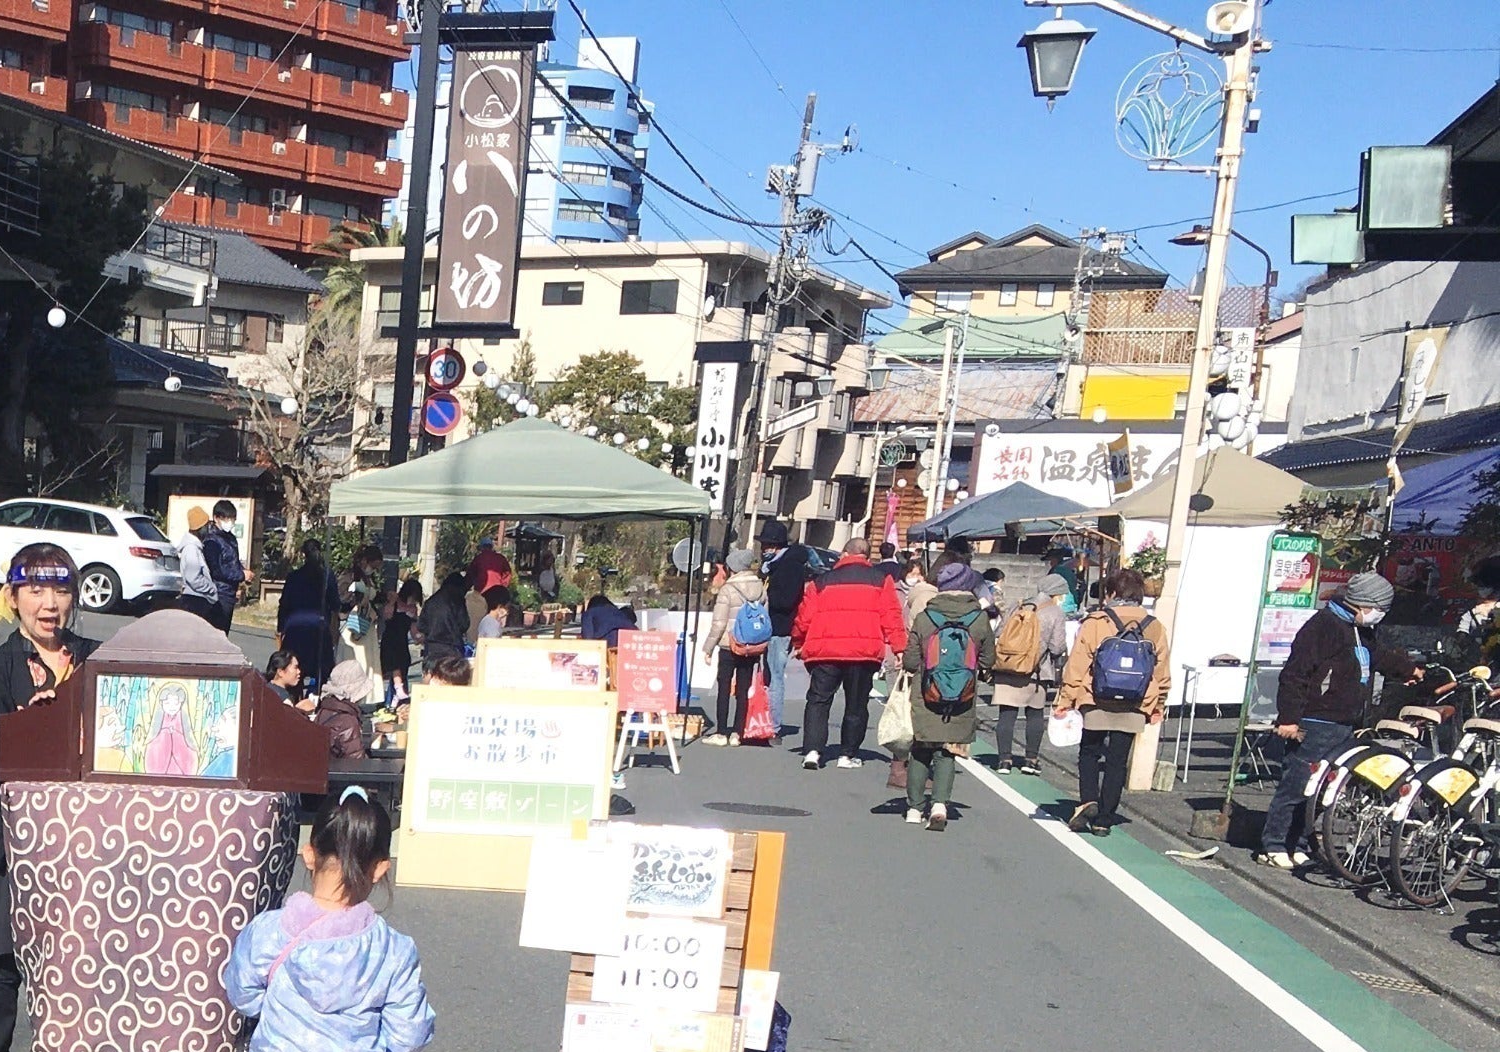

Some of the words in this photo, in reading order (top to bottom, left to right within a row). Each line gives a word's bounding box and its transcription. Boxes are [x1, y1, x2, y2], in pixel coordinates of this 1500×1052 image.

[464, 133, 511, 148] 小松家
[450, 151, 519, 309] 八の坊
[1233, 332, 1249, 382] 南山荘
[434, 360, 457, 379] 30
[1276, 540, 1314, 551] バスのりば
[462, 715, 537, 738] 温泉場
[624, 934, 700, 956] 10:00
[621, 968, 698, 989] 11:00
